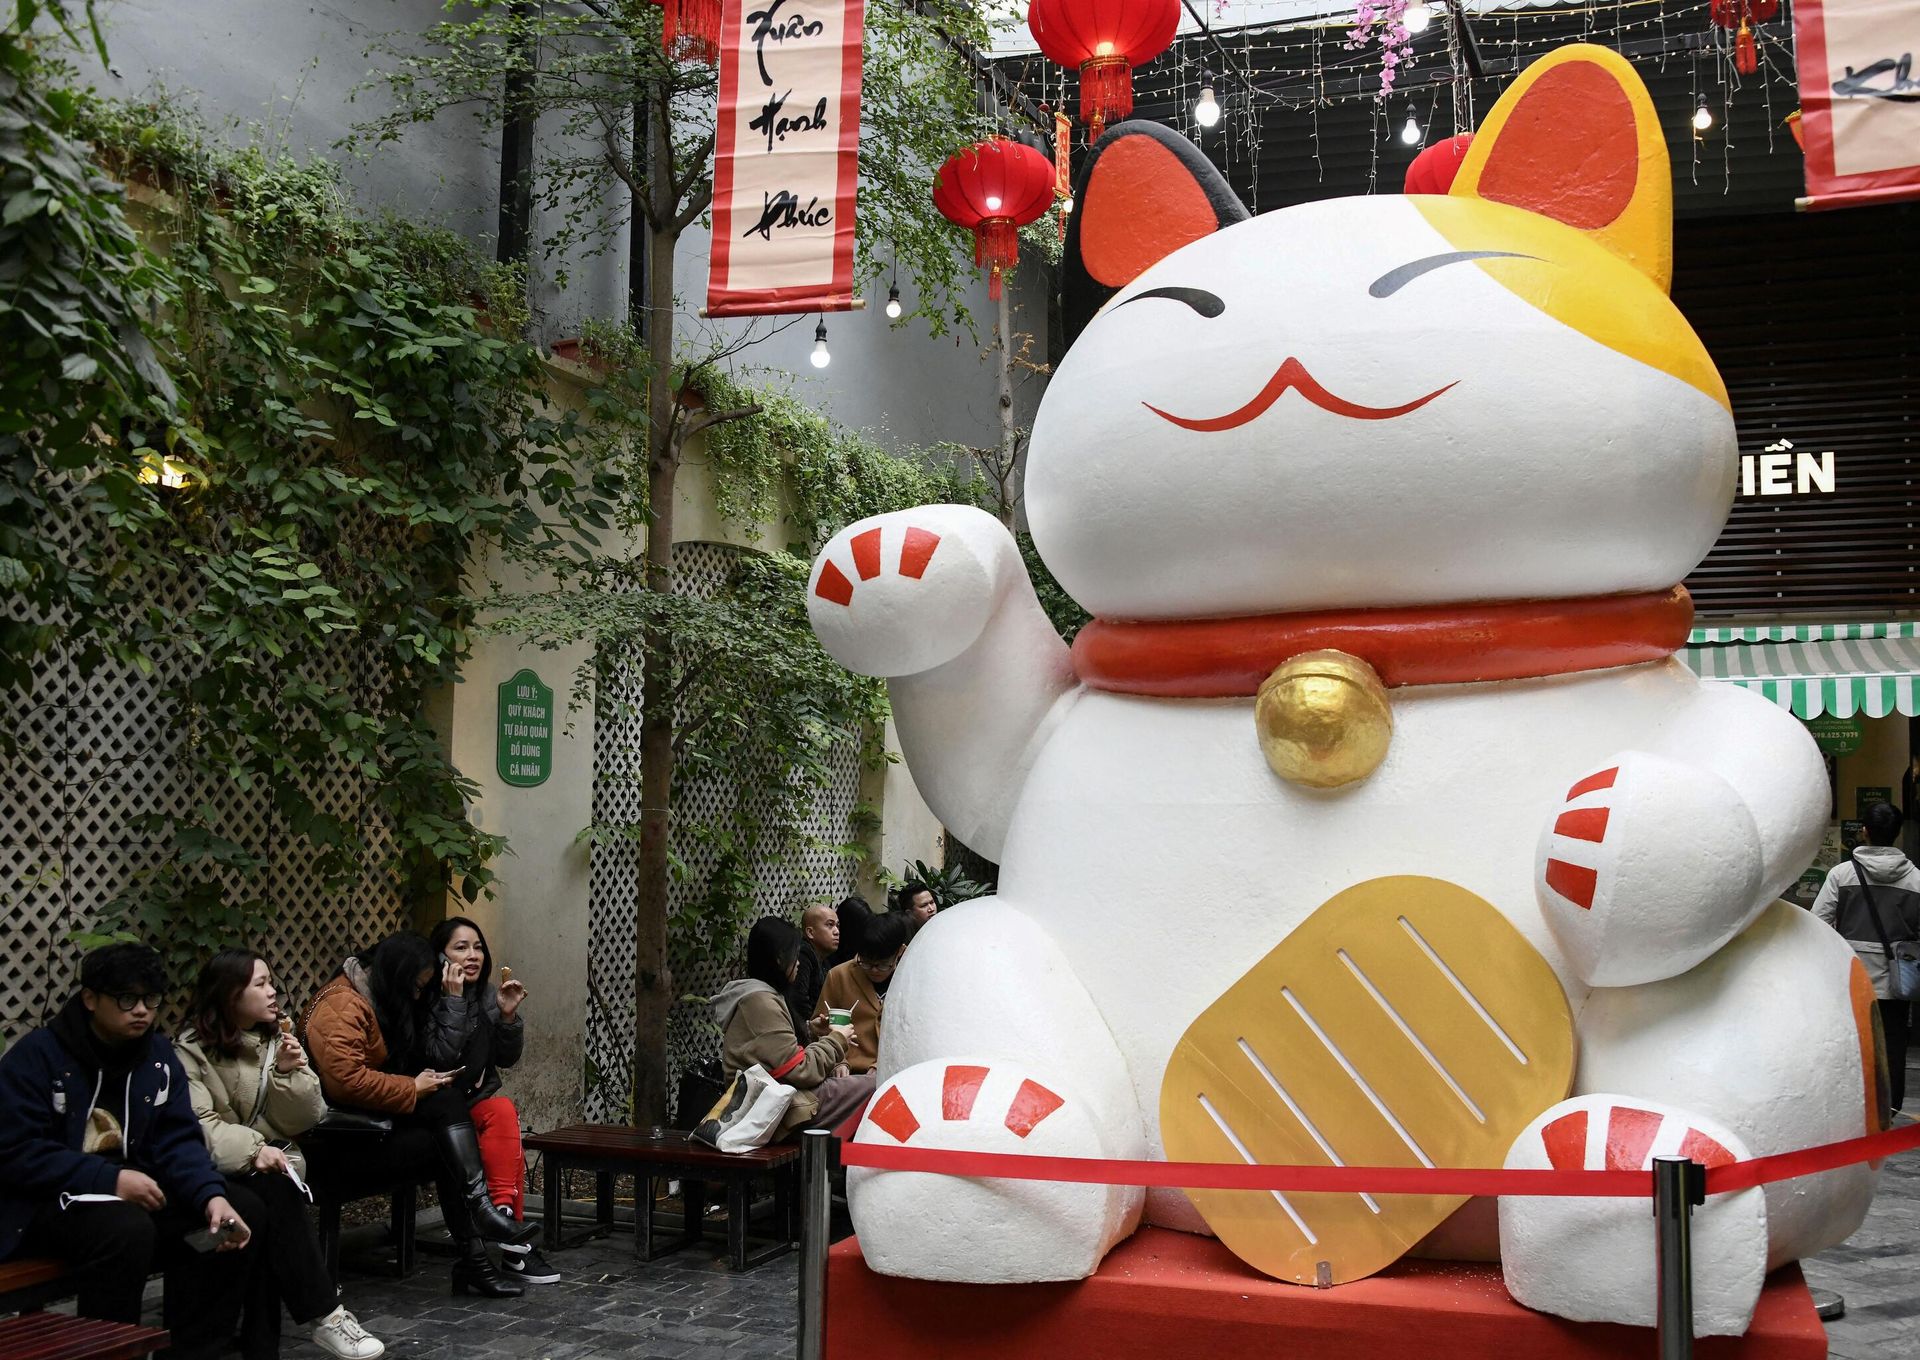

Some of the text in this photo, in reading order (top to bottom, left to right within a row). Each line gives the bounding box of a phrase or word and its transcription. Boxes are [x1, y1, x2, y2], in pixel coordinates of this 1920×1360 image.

[749, 88, 828, 154] Hạnh
[743, 190, 833, 241] Phúc
[508, 703, 545, 719] QUÝ KHÁCH
[504, 721, 547, 738] TỰ BẢO QUẢN
[510, 761, 540, 776] CÁ NHÂN
